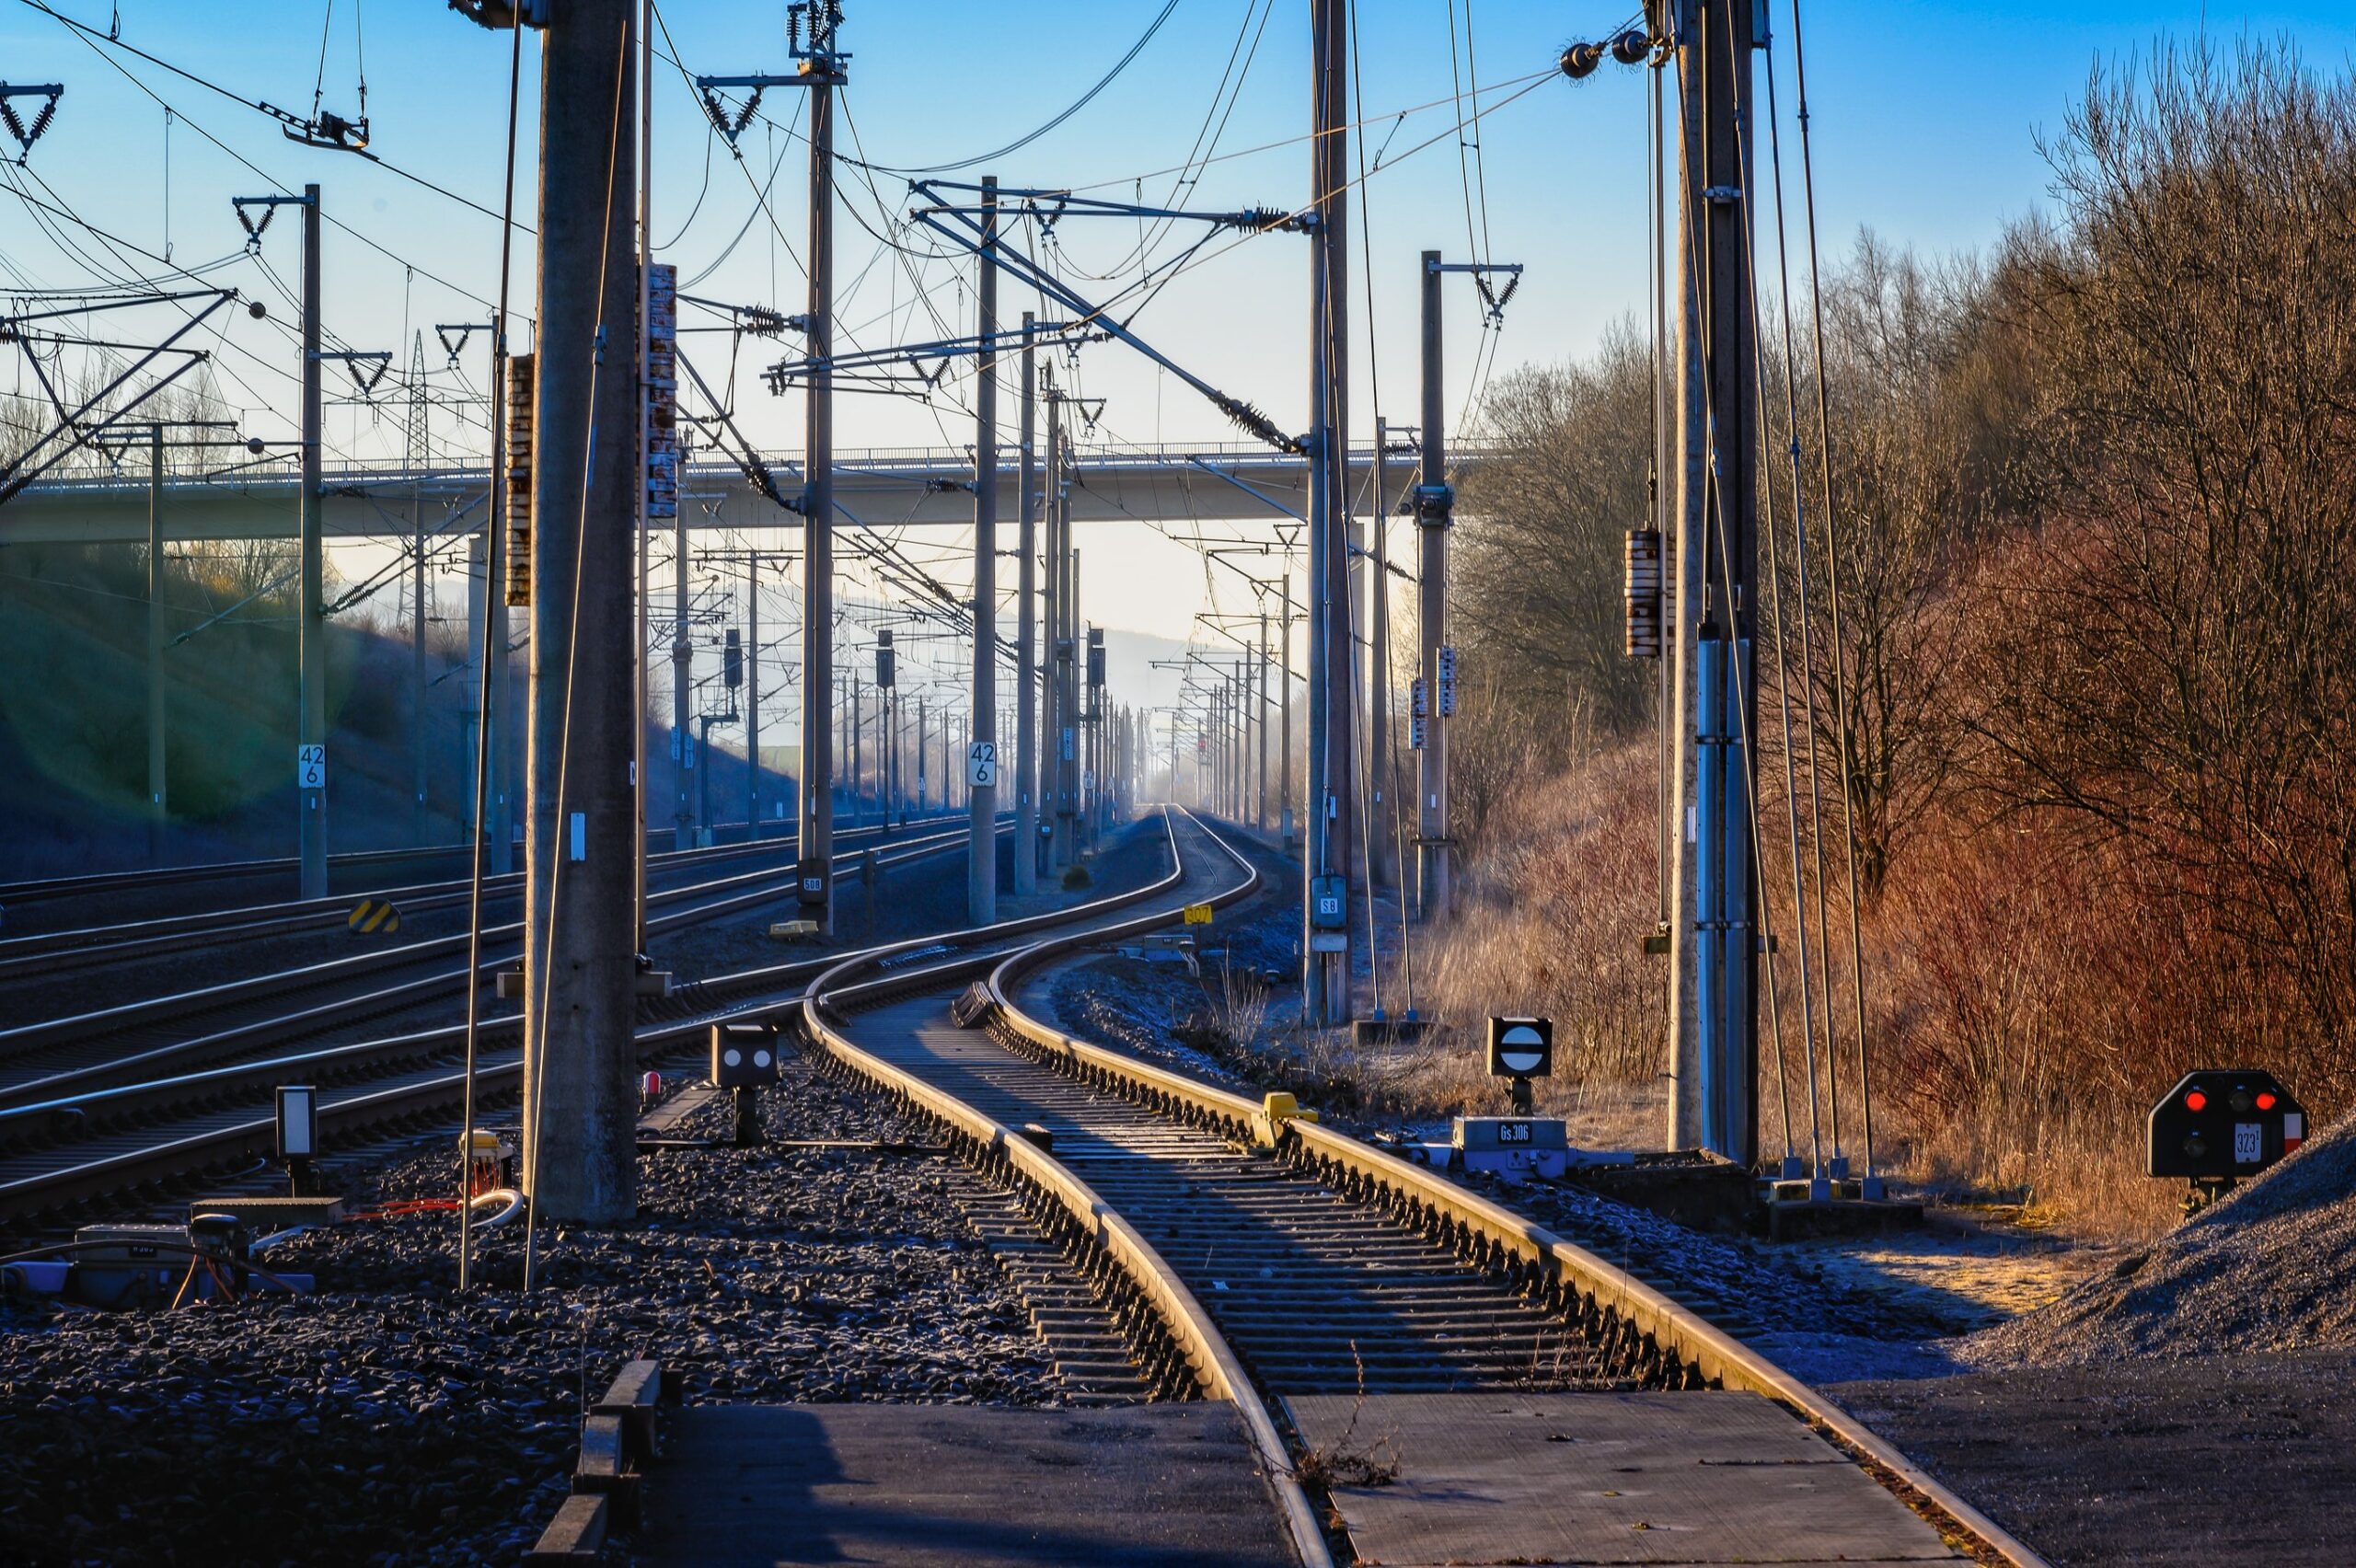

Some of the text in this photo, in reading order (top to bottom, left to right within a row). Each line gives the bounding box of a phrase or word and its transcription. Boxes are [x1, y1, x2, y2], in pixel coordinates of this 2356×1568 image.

[301, 746, 324, 765] 42
[971, 744, 994, 763] 42
[306, 766, 318, 784] 6
[976, 764, 988, 782] 6
[1186, 906, 1209, 923] 307
[1501, 1124, 1530, 1141] Gs 306
